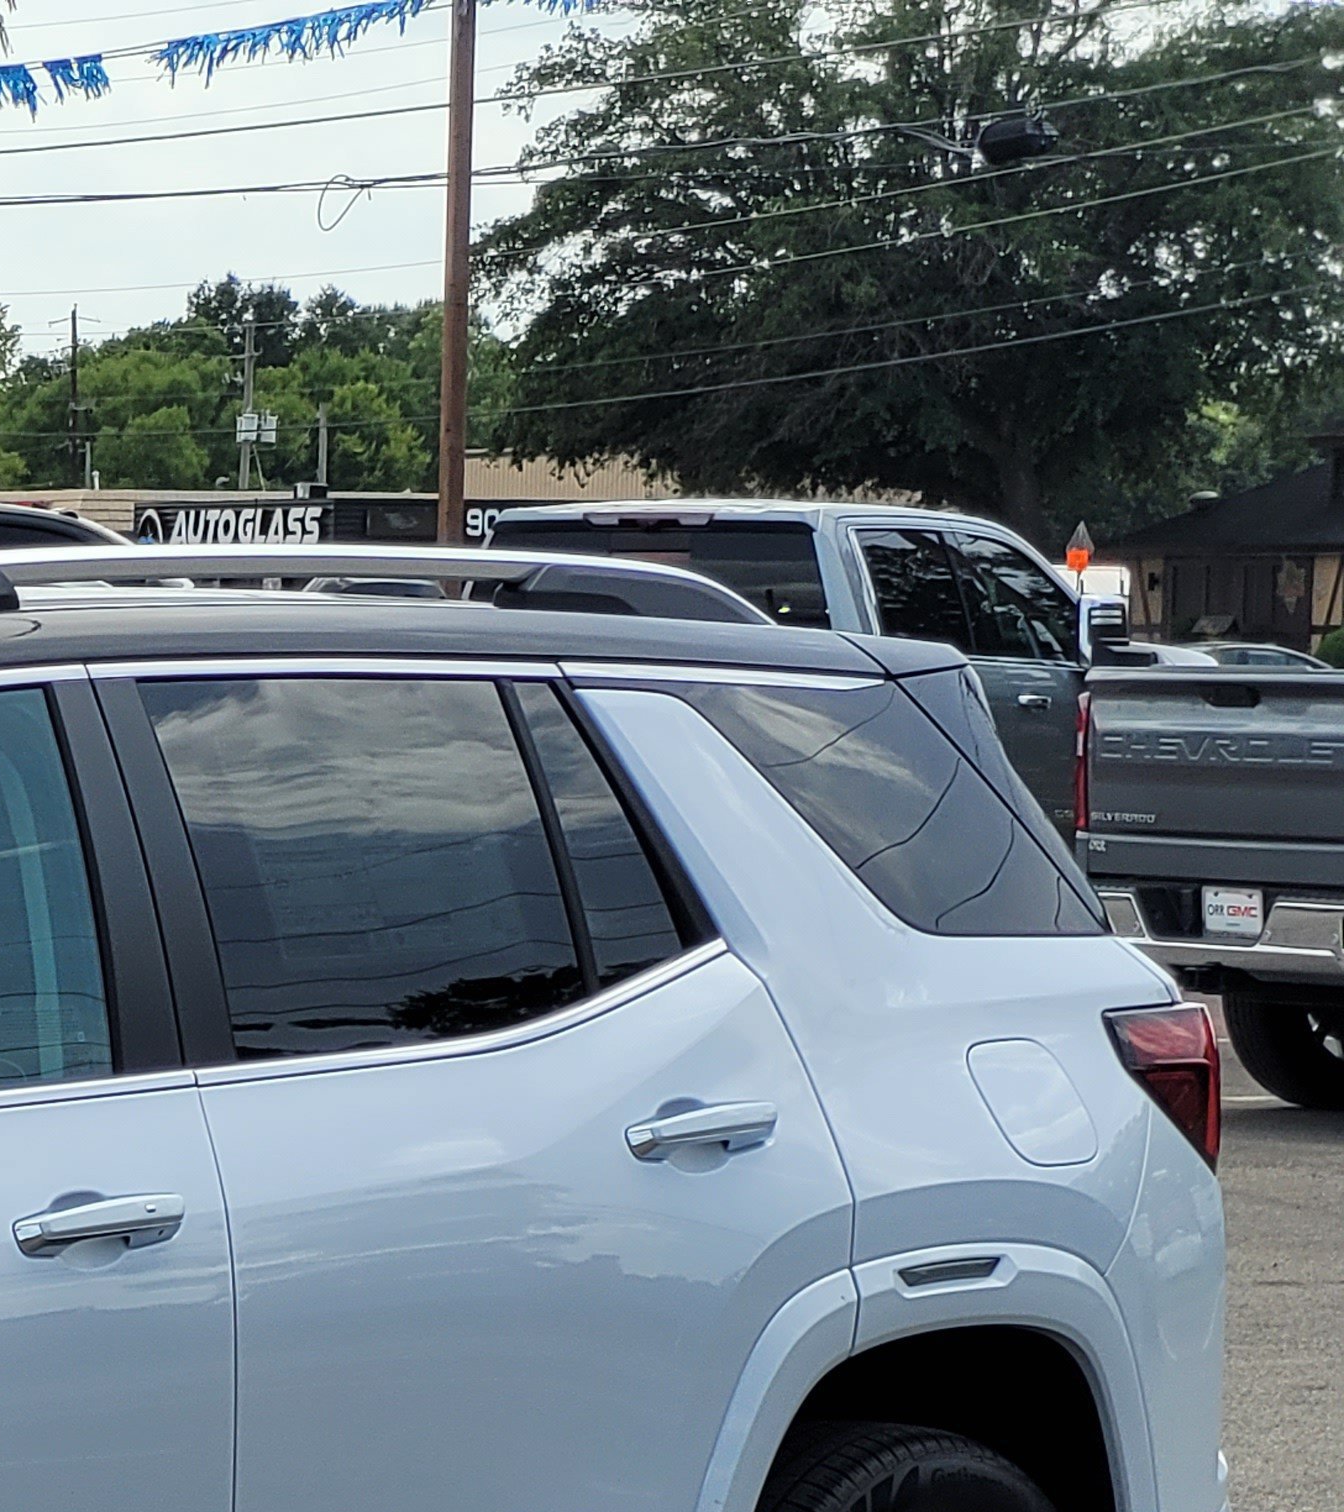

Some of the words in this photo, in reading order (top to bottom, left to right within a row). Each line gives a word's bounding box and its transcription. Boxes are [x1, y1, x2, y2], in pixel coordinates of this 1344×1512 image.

[1091, 811, 1156, 823] SILVERADO
[1207, 903, 1225, 916] ORR
[1226, 905, 1258, 918] GMC
